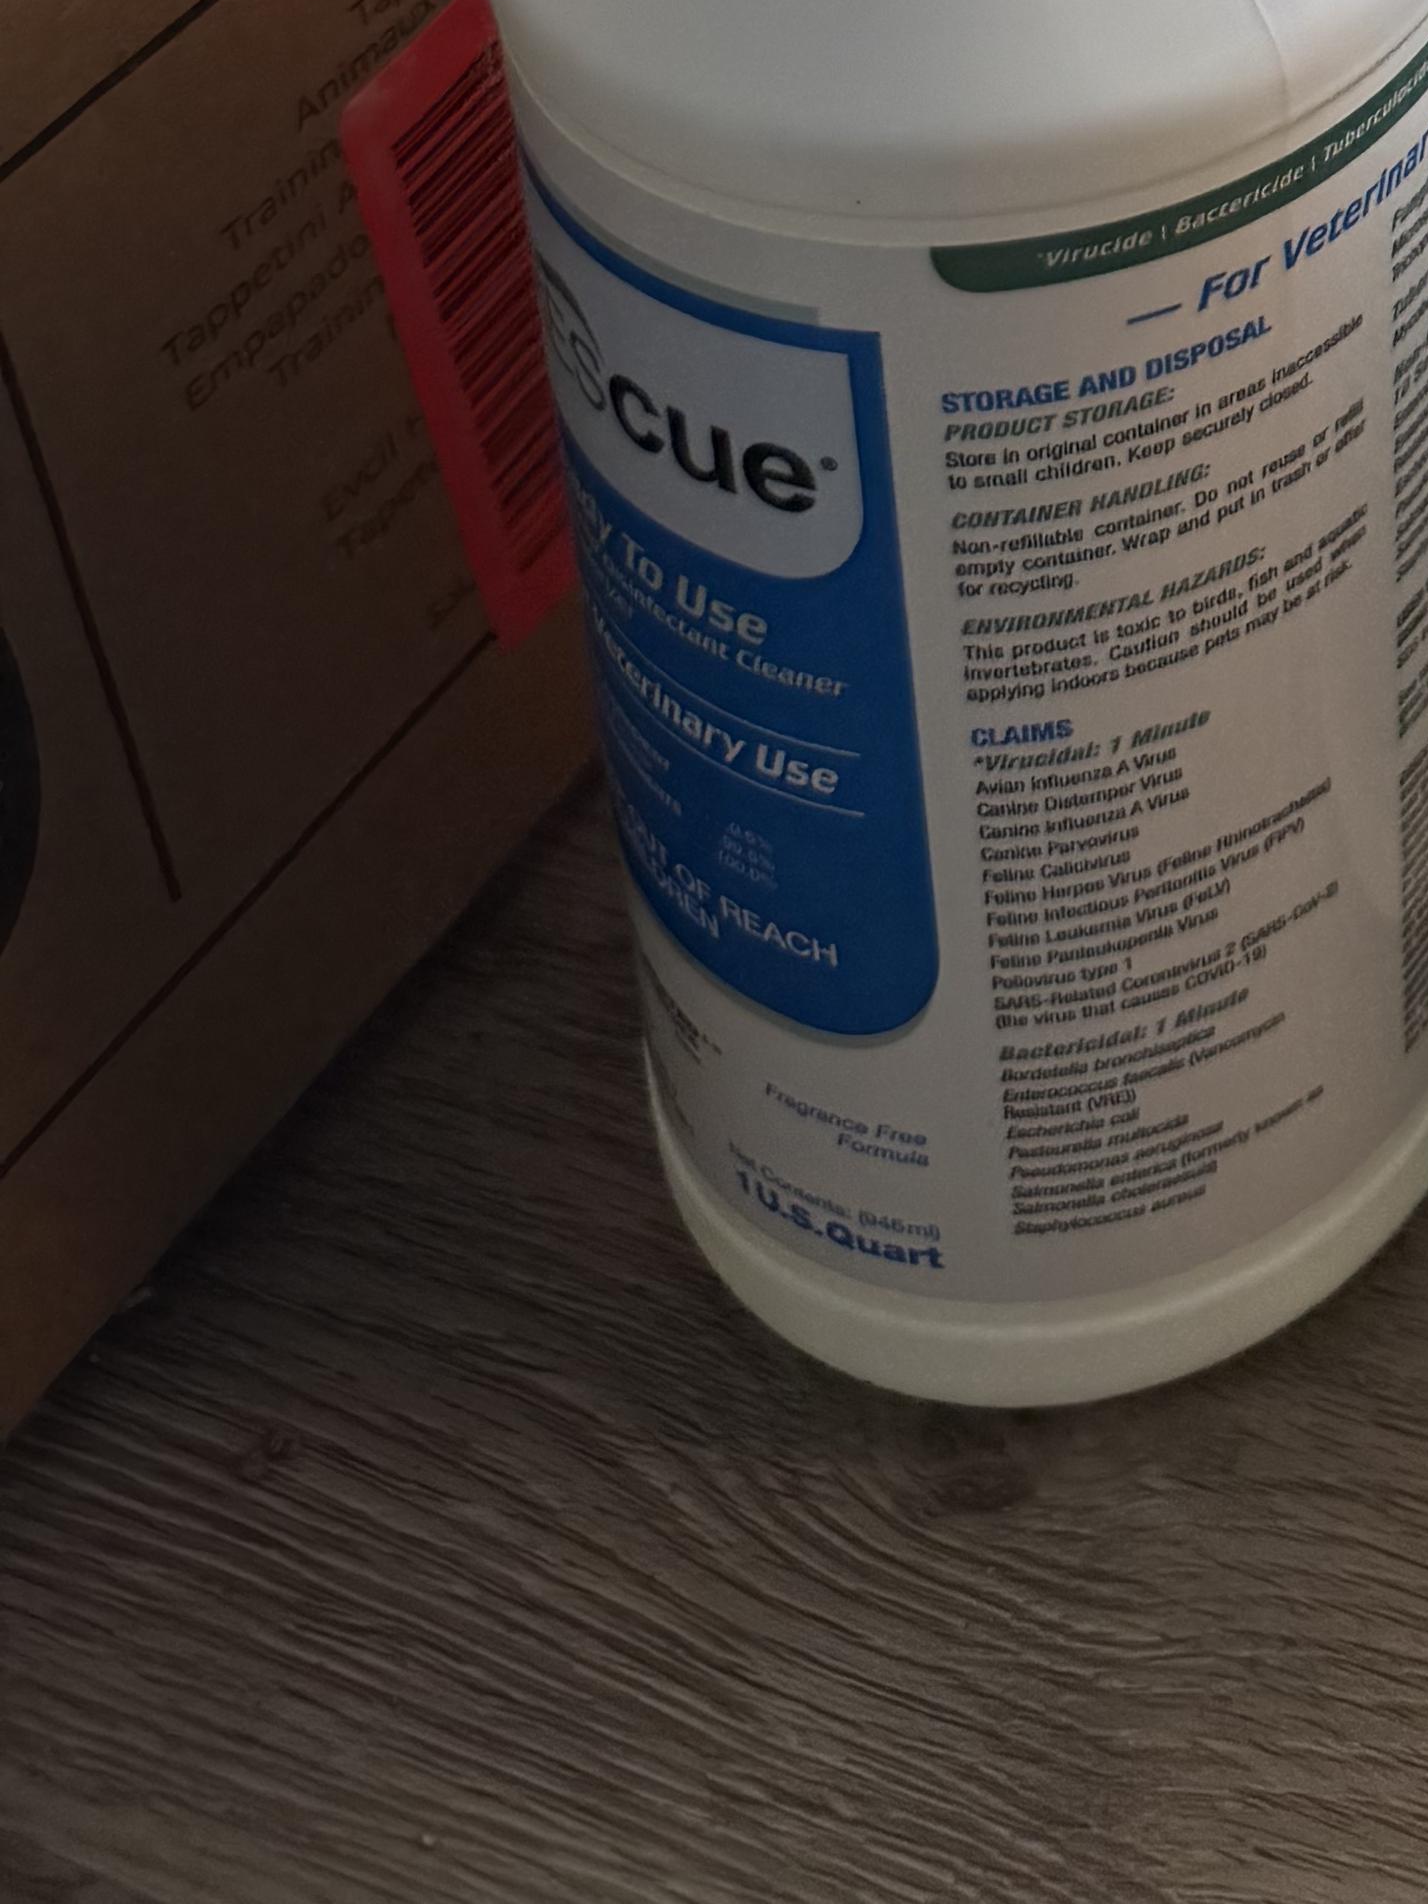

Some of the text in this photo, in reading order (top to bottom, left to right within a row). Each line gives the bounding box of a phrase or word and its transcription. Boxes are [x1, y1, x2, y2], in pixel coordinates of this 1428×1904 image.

[1175, 163, 1304, 236] Bactericide
[1196, 255, 1272, 312] For
[942, 315, 1272, 415] STORAGE AND DISPOSAL
[945, 385, 1175, 441] PRODUCT STORAGE:
[946, 379, 1266, 468] Store in original container in areas
[948, 372, 1313, 490] to small children. Keep securely closed.
[952, 463, 1211, 530] CONTAINER HANDLING:
[952, 446, 1306, 555] Non-refillable container. Do not reuse
[955, 498, 1245, 580] empty container. Wrap and put
[622, 533, 767, 645] To Use
[961, 546, 1268, 636] ENVIRONMENTAL HAZARDS:
[737, 649, 850, 697] Cleaner
[970, 719, 1073, 748] CLAIMS
[1130, 710, 1211, 748] Minute
[756, 744, 838, 794] Use
[720, 896, 838, 968] REACH
[765, 1082, 927, 1146] Fragrance Free
[837, 1133, 930, 1167] Formula
